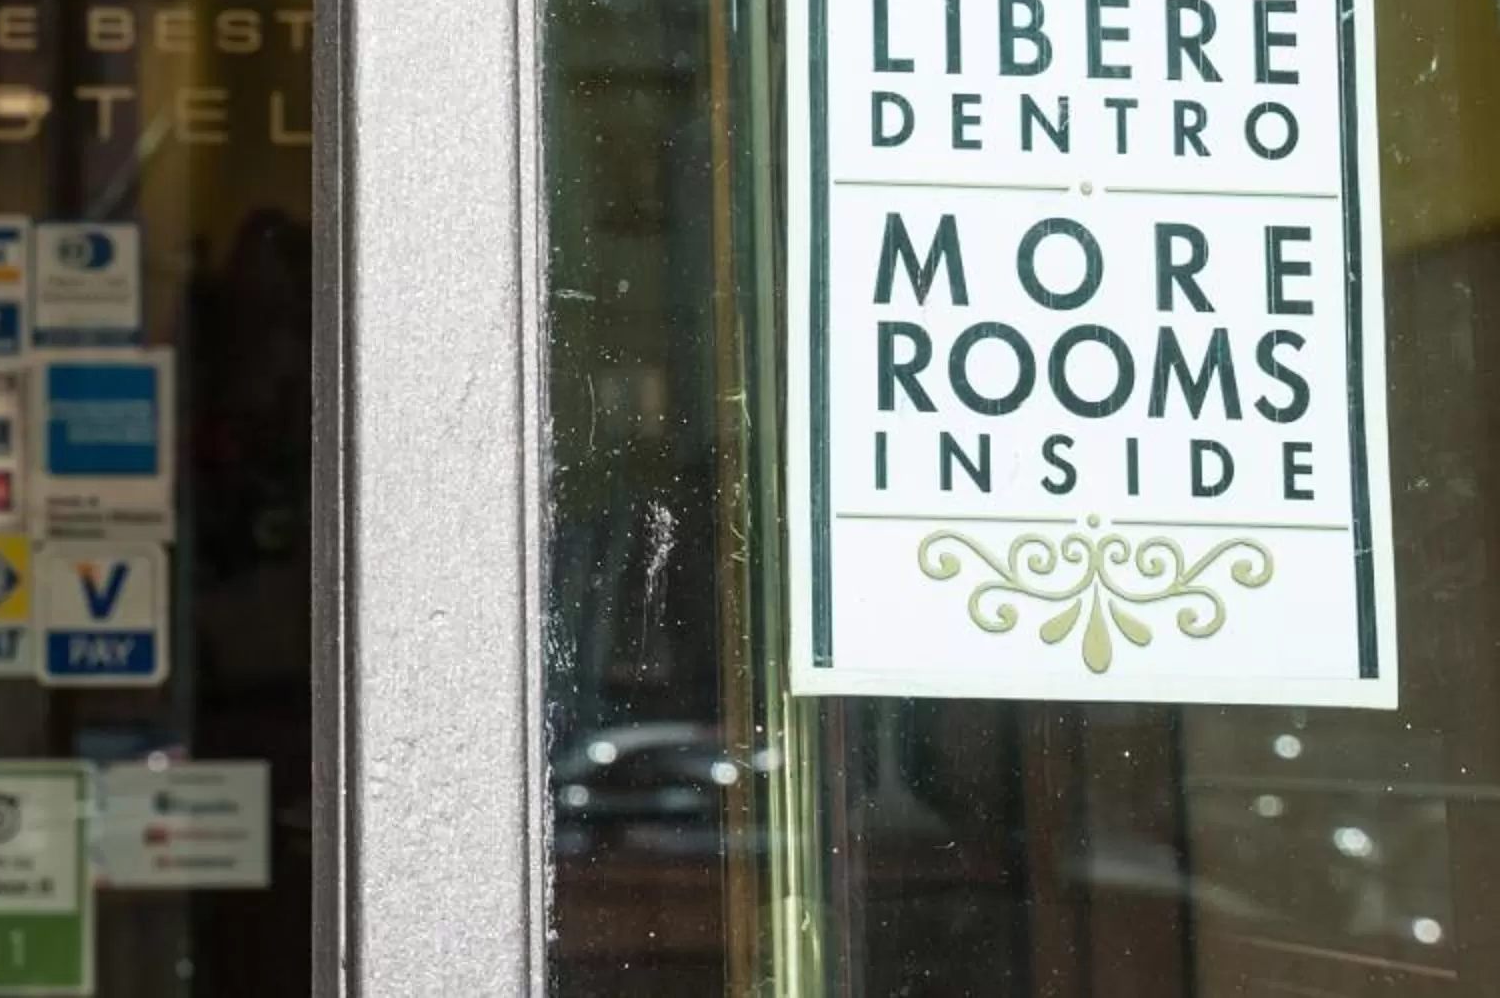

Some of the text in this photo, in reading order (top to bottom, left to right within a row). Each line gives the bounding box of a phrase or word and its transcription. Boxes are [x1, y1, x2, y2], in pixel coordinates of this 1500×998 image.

[87, 7, 313, 52] BEST
[871, 91, 1300, 161] DENTRO
[873, 212, 1314, 315] MORE
[877, 321, 1311, 424] ROOMS
[875, 431, 1314, 501] INSIDE
[74, 561, 131, 621] V
[67, 636, 136, 667] PAY
